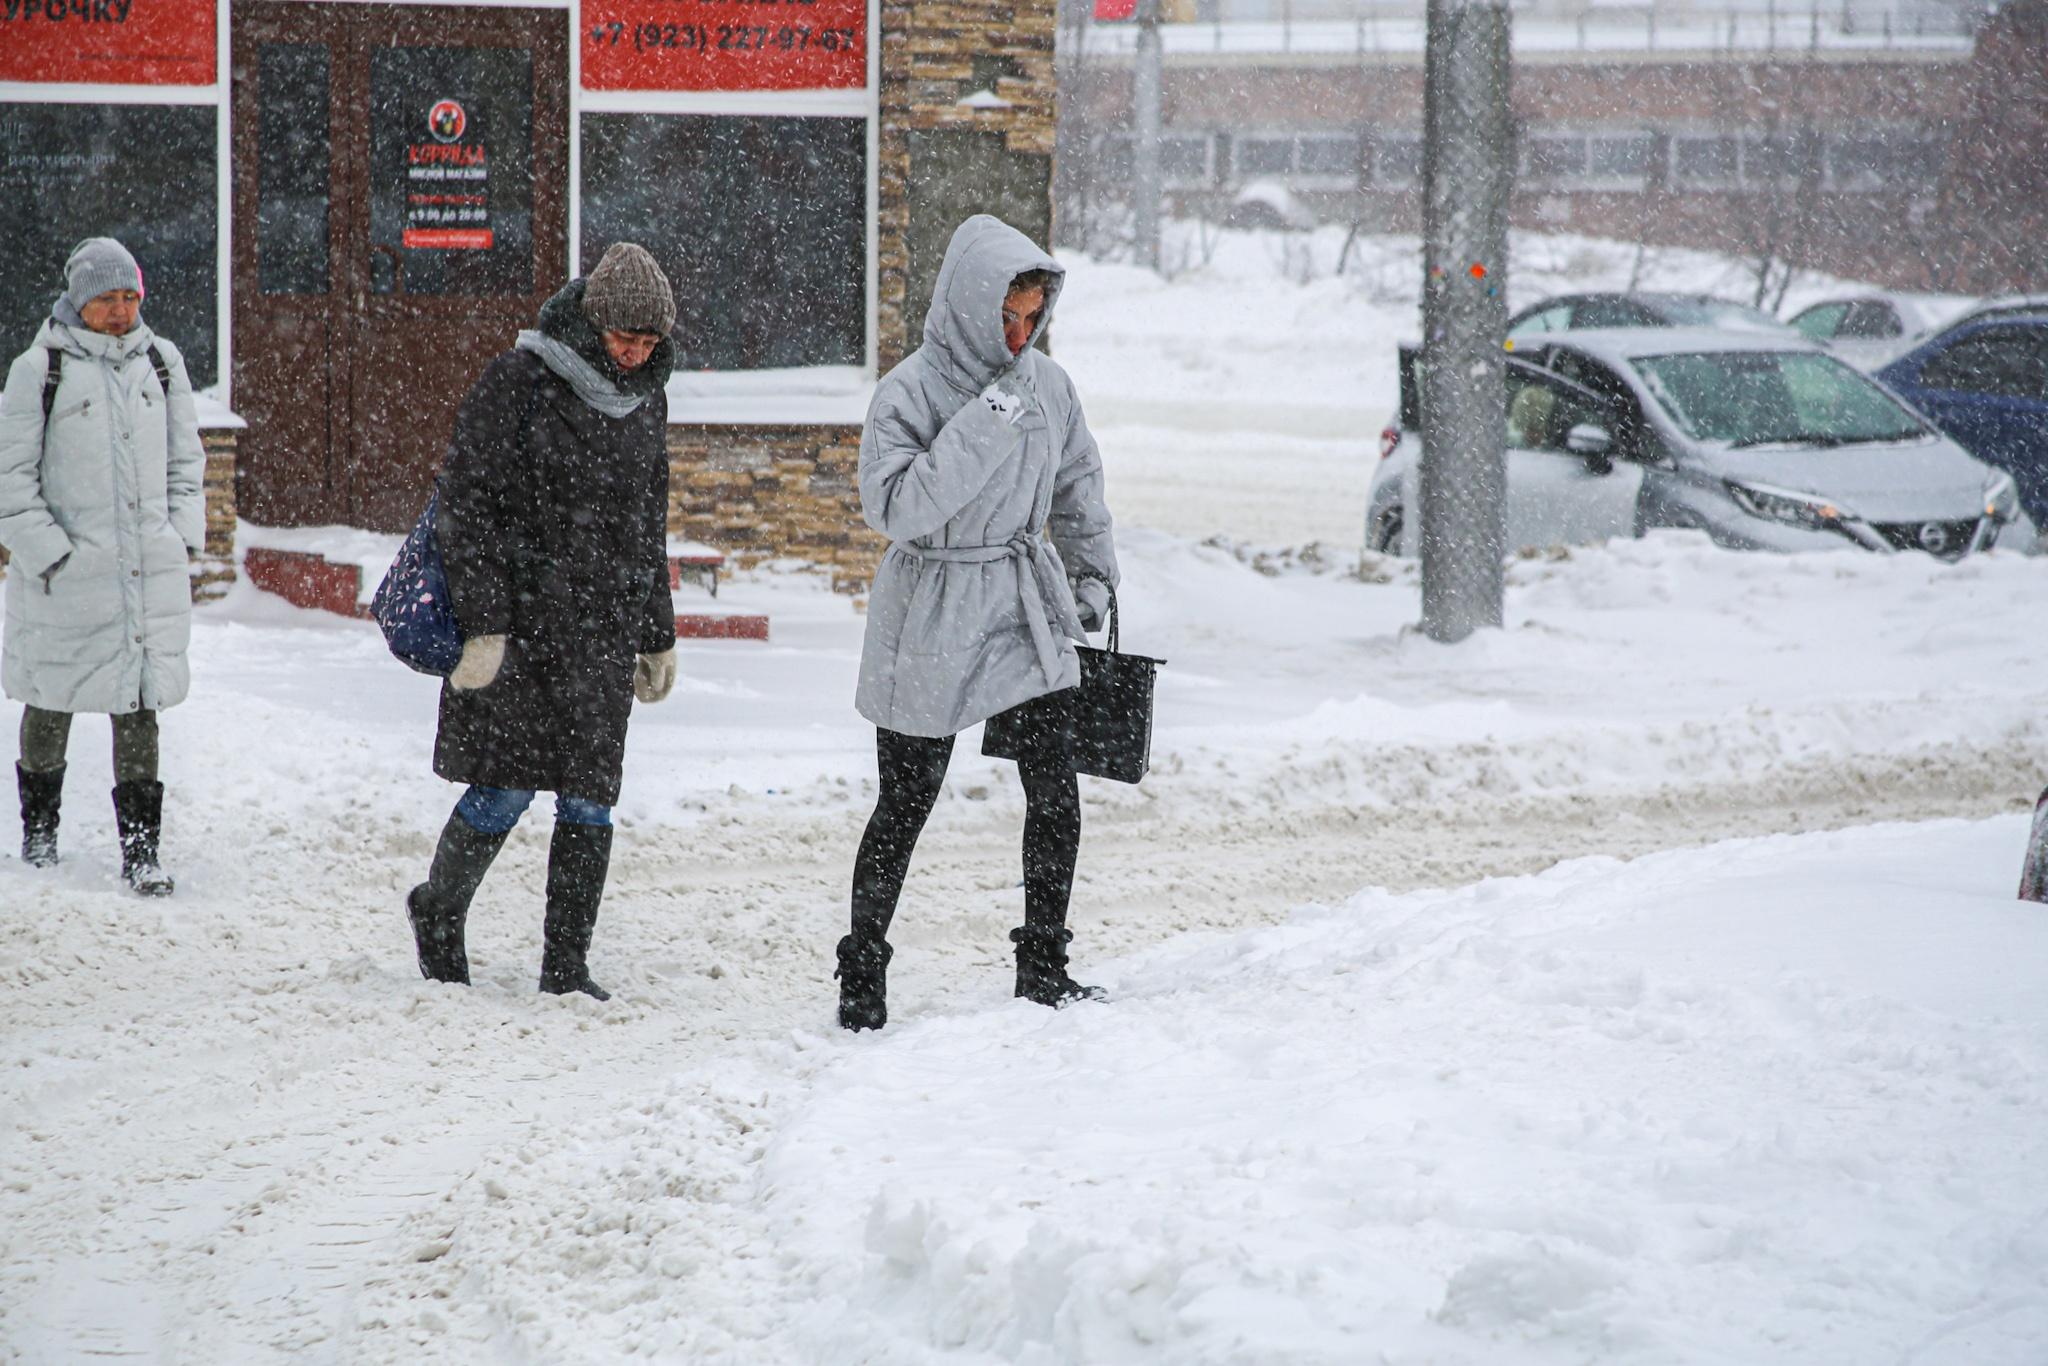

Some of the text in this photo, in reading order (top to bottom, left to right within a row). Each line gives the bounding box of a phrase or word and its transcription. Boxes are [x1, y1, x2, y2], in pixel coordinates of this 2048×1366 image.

[0, 0, 131, 23] УРОЧКУ
[591, 22, 623, 46] +7
[635, 23, 706, 53] (923)
[409, 144, 485, 165] КОРРИДА
